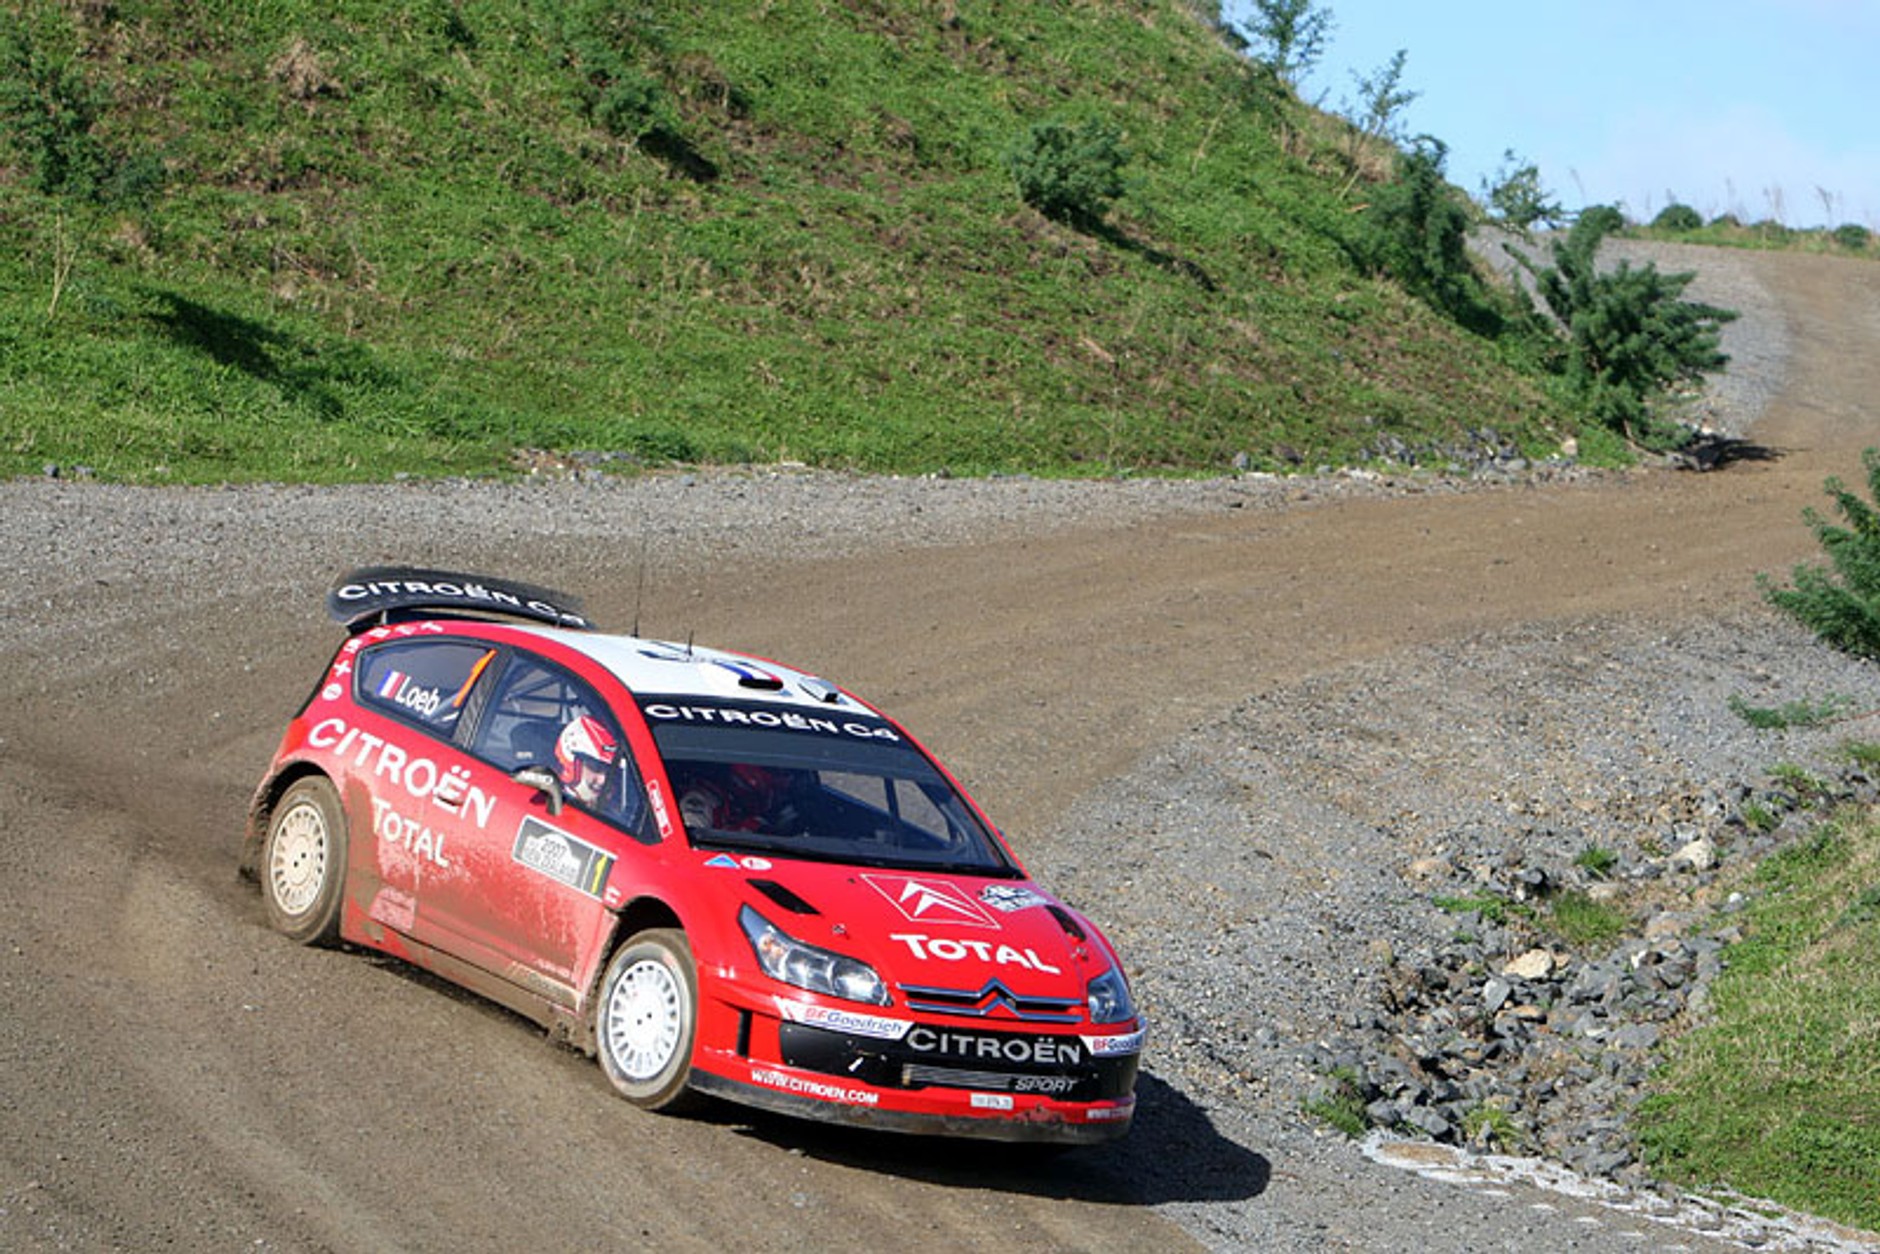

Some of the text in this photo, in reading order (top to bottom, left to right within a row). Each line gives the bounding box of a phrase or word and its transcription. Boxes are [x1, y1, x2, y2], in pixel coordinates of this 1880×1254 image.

[338, 581, 520, 606] CITROËN
[395, 676, 440, 715] Loeb
[645, 704, 899, 741] CITROËN C4
[308, 718, 497, 828] CITROËN
[805, 1007, 902, 1033] BFGoodrich
[907, 1027, 1081, 1065] CITROËN
[1014, 1077, 1077, 1092] SPORT
